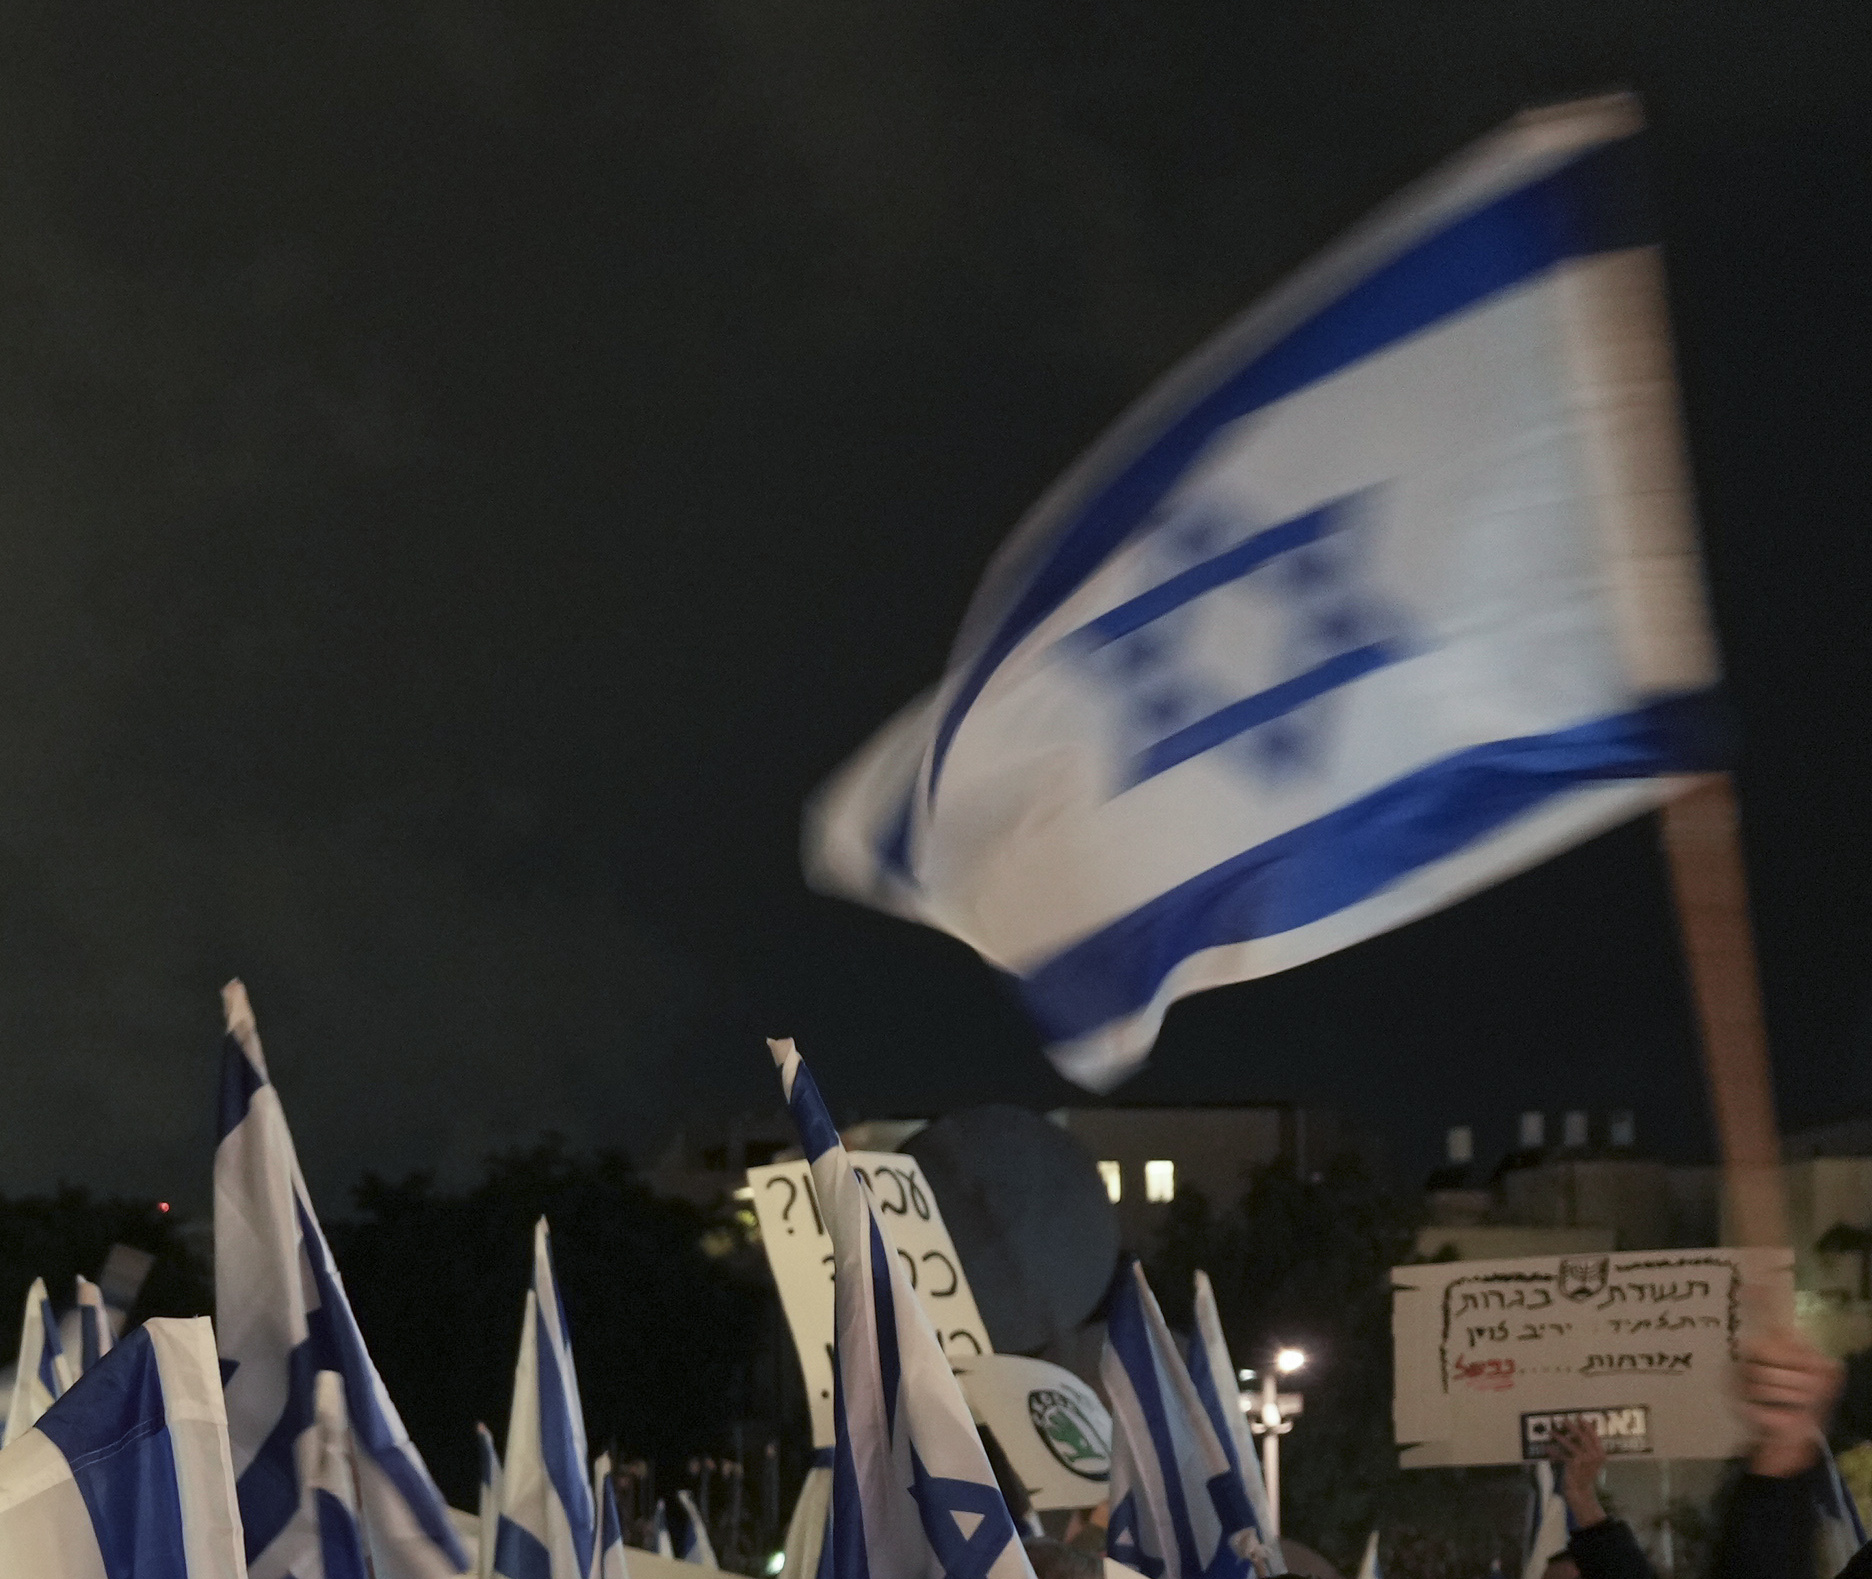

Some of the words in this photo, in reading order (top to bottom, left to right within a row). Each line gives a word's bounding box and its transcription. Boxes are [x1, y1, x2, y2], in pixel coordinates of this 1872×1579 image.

[1456, 1287, 1554, 1317] בגרות
[1465, 1320, 1510, 1348] לוין
[1517, 1320, 1573, 1341] יריב
[1581, 1351, 1693, 1374] אזרחות
